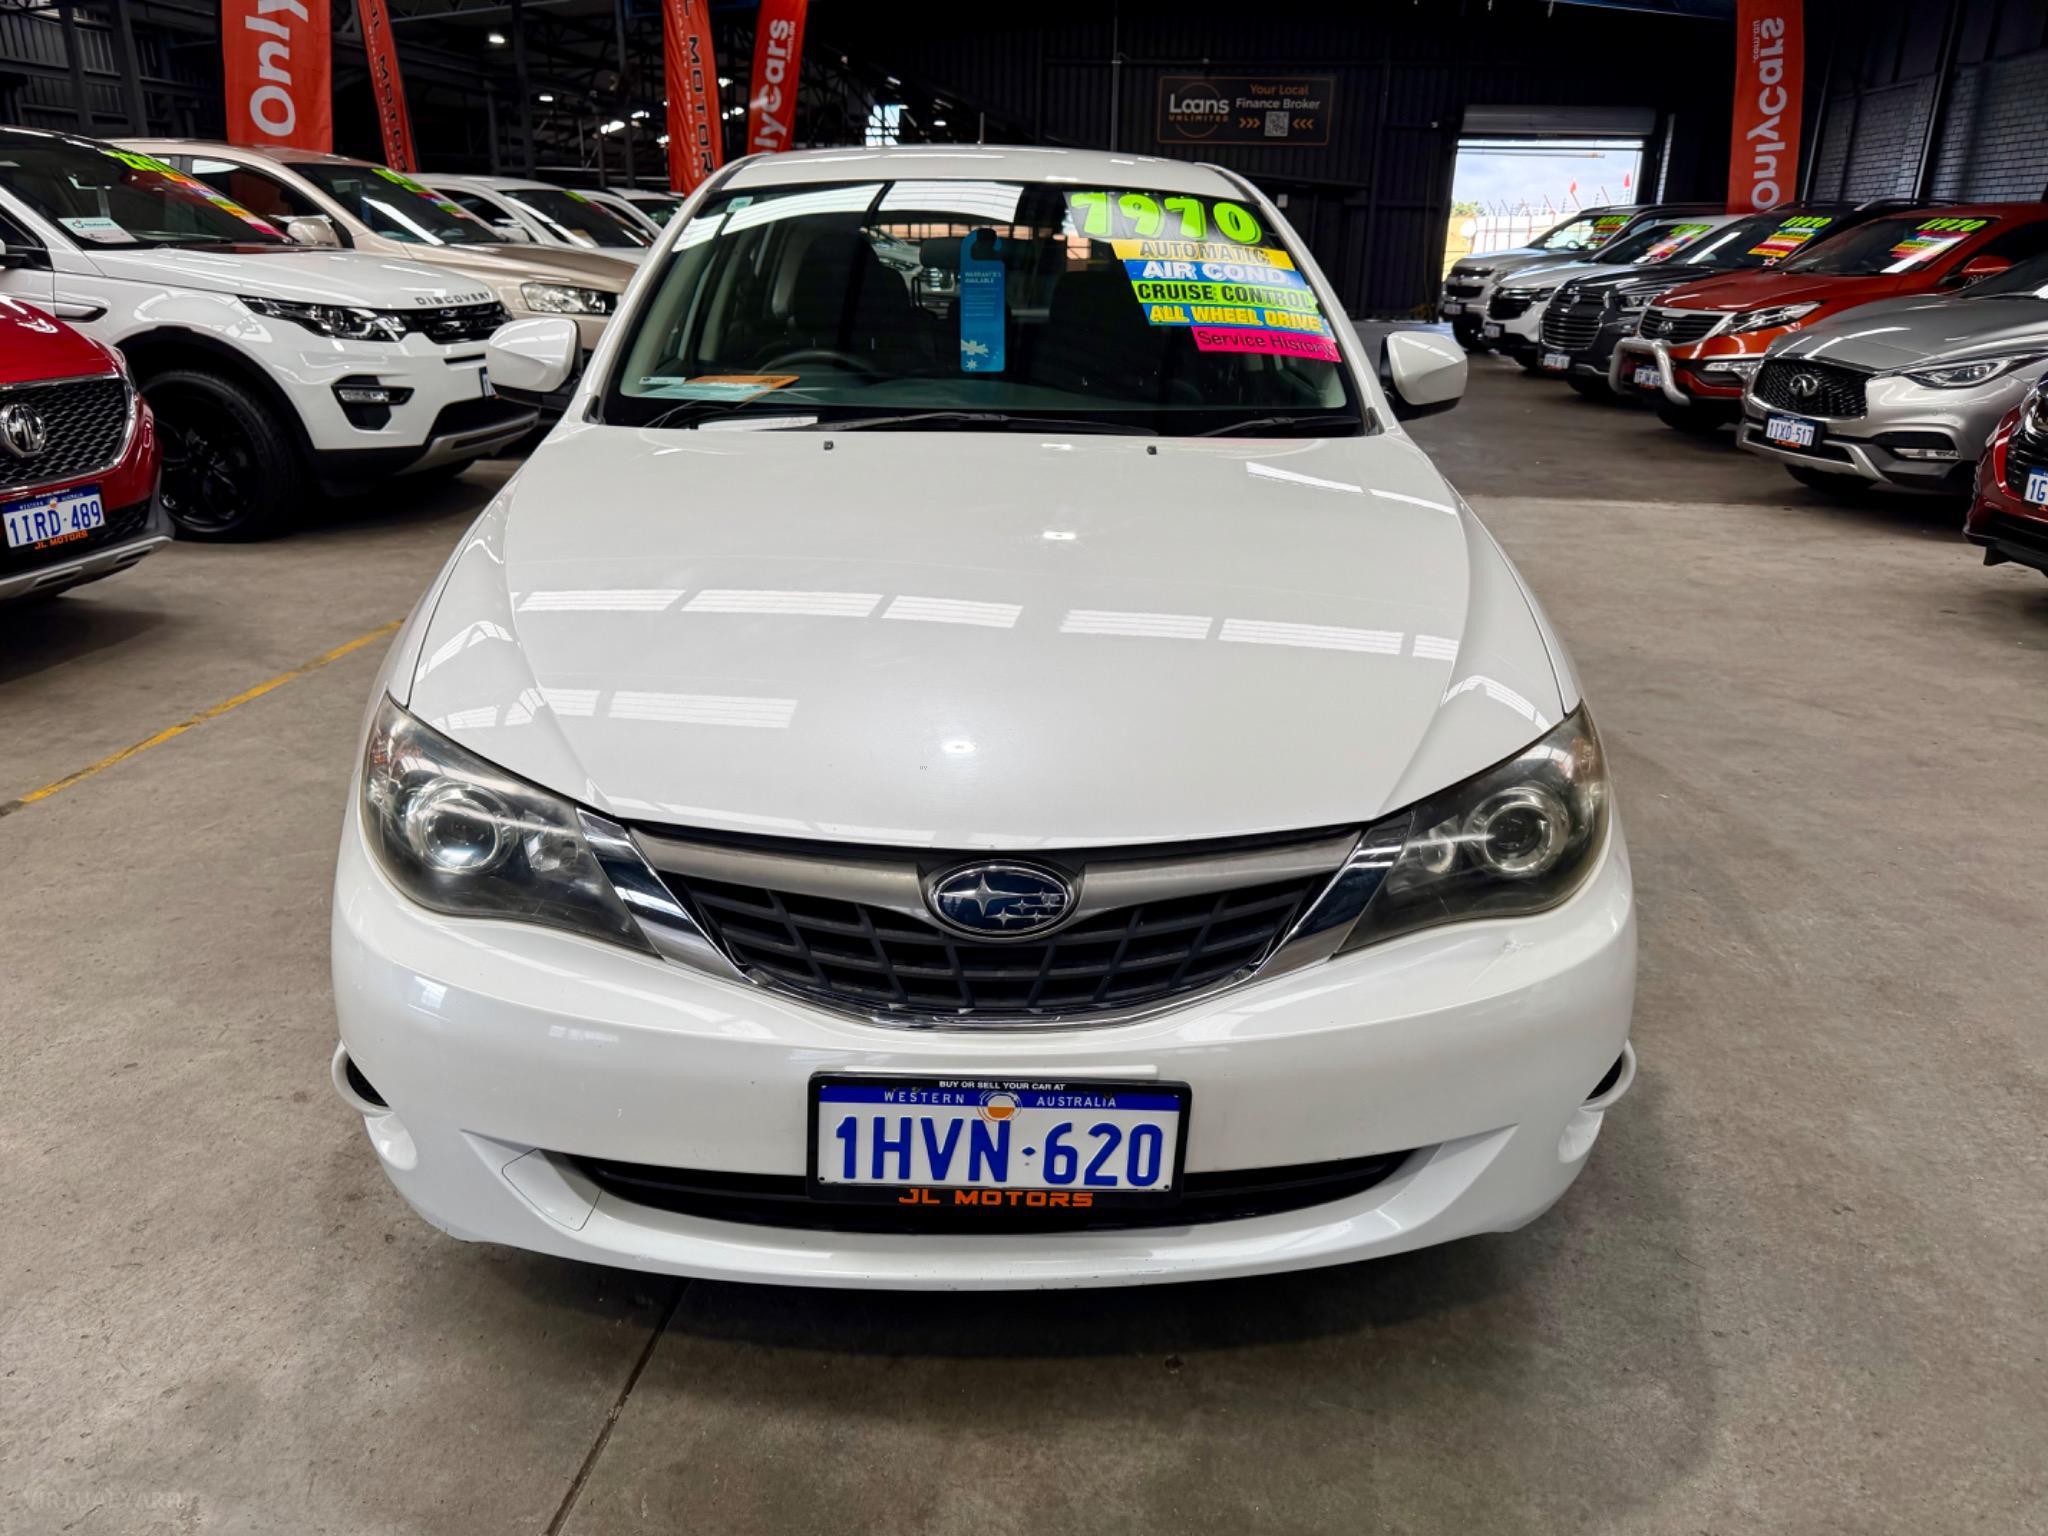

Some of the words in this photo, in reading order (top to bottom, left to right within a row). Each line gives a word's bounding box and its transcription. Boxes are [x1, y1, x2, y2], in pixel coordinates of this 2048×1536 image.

[1250, 84, 1276, 95] Your
[1279, 84, 1309, 95] Local
[1169, 94, 1230, 114] Loans
[1235, 98, 1279, 109] Finance
[1282, 98, 1320, 110] Broker
[1168, 114, 1229, 122] UNLIMITED
[1071, 193, 1262, 244] 7970
[1139, 242, 1271, 265] AUTOMATIC
[1142, 261, 1198, 281] AIR
[1138, 283, 1215, 301] CRUISE
[1221, 286, 1312, 309] CONTROL
[1150, 305, 1191, 323] ALL
[1192, 307, 1264, 326] WHEEL
[1265, 310, 1323, 333] DRIVE
[1197, 331, 1265, 347] Service
[49, 530, 89, 546] MOTORS
[961, 1081, 975, 1089] OR
[1031, 1083, 1052, 1091] CAR
[884, 1091, 965, 1104] WESTERN
[1036, 1096, 1117, 1108] AUSTRALIA
[898, 1188, 940, 1205] JL
[955, 1190, 1094, 1208] MOTORS
